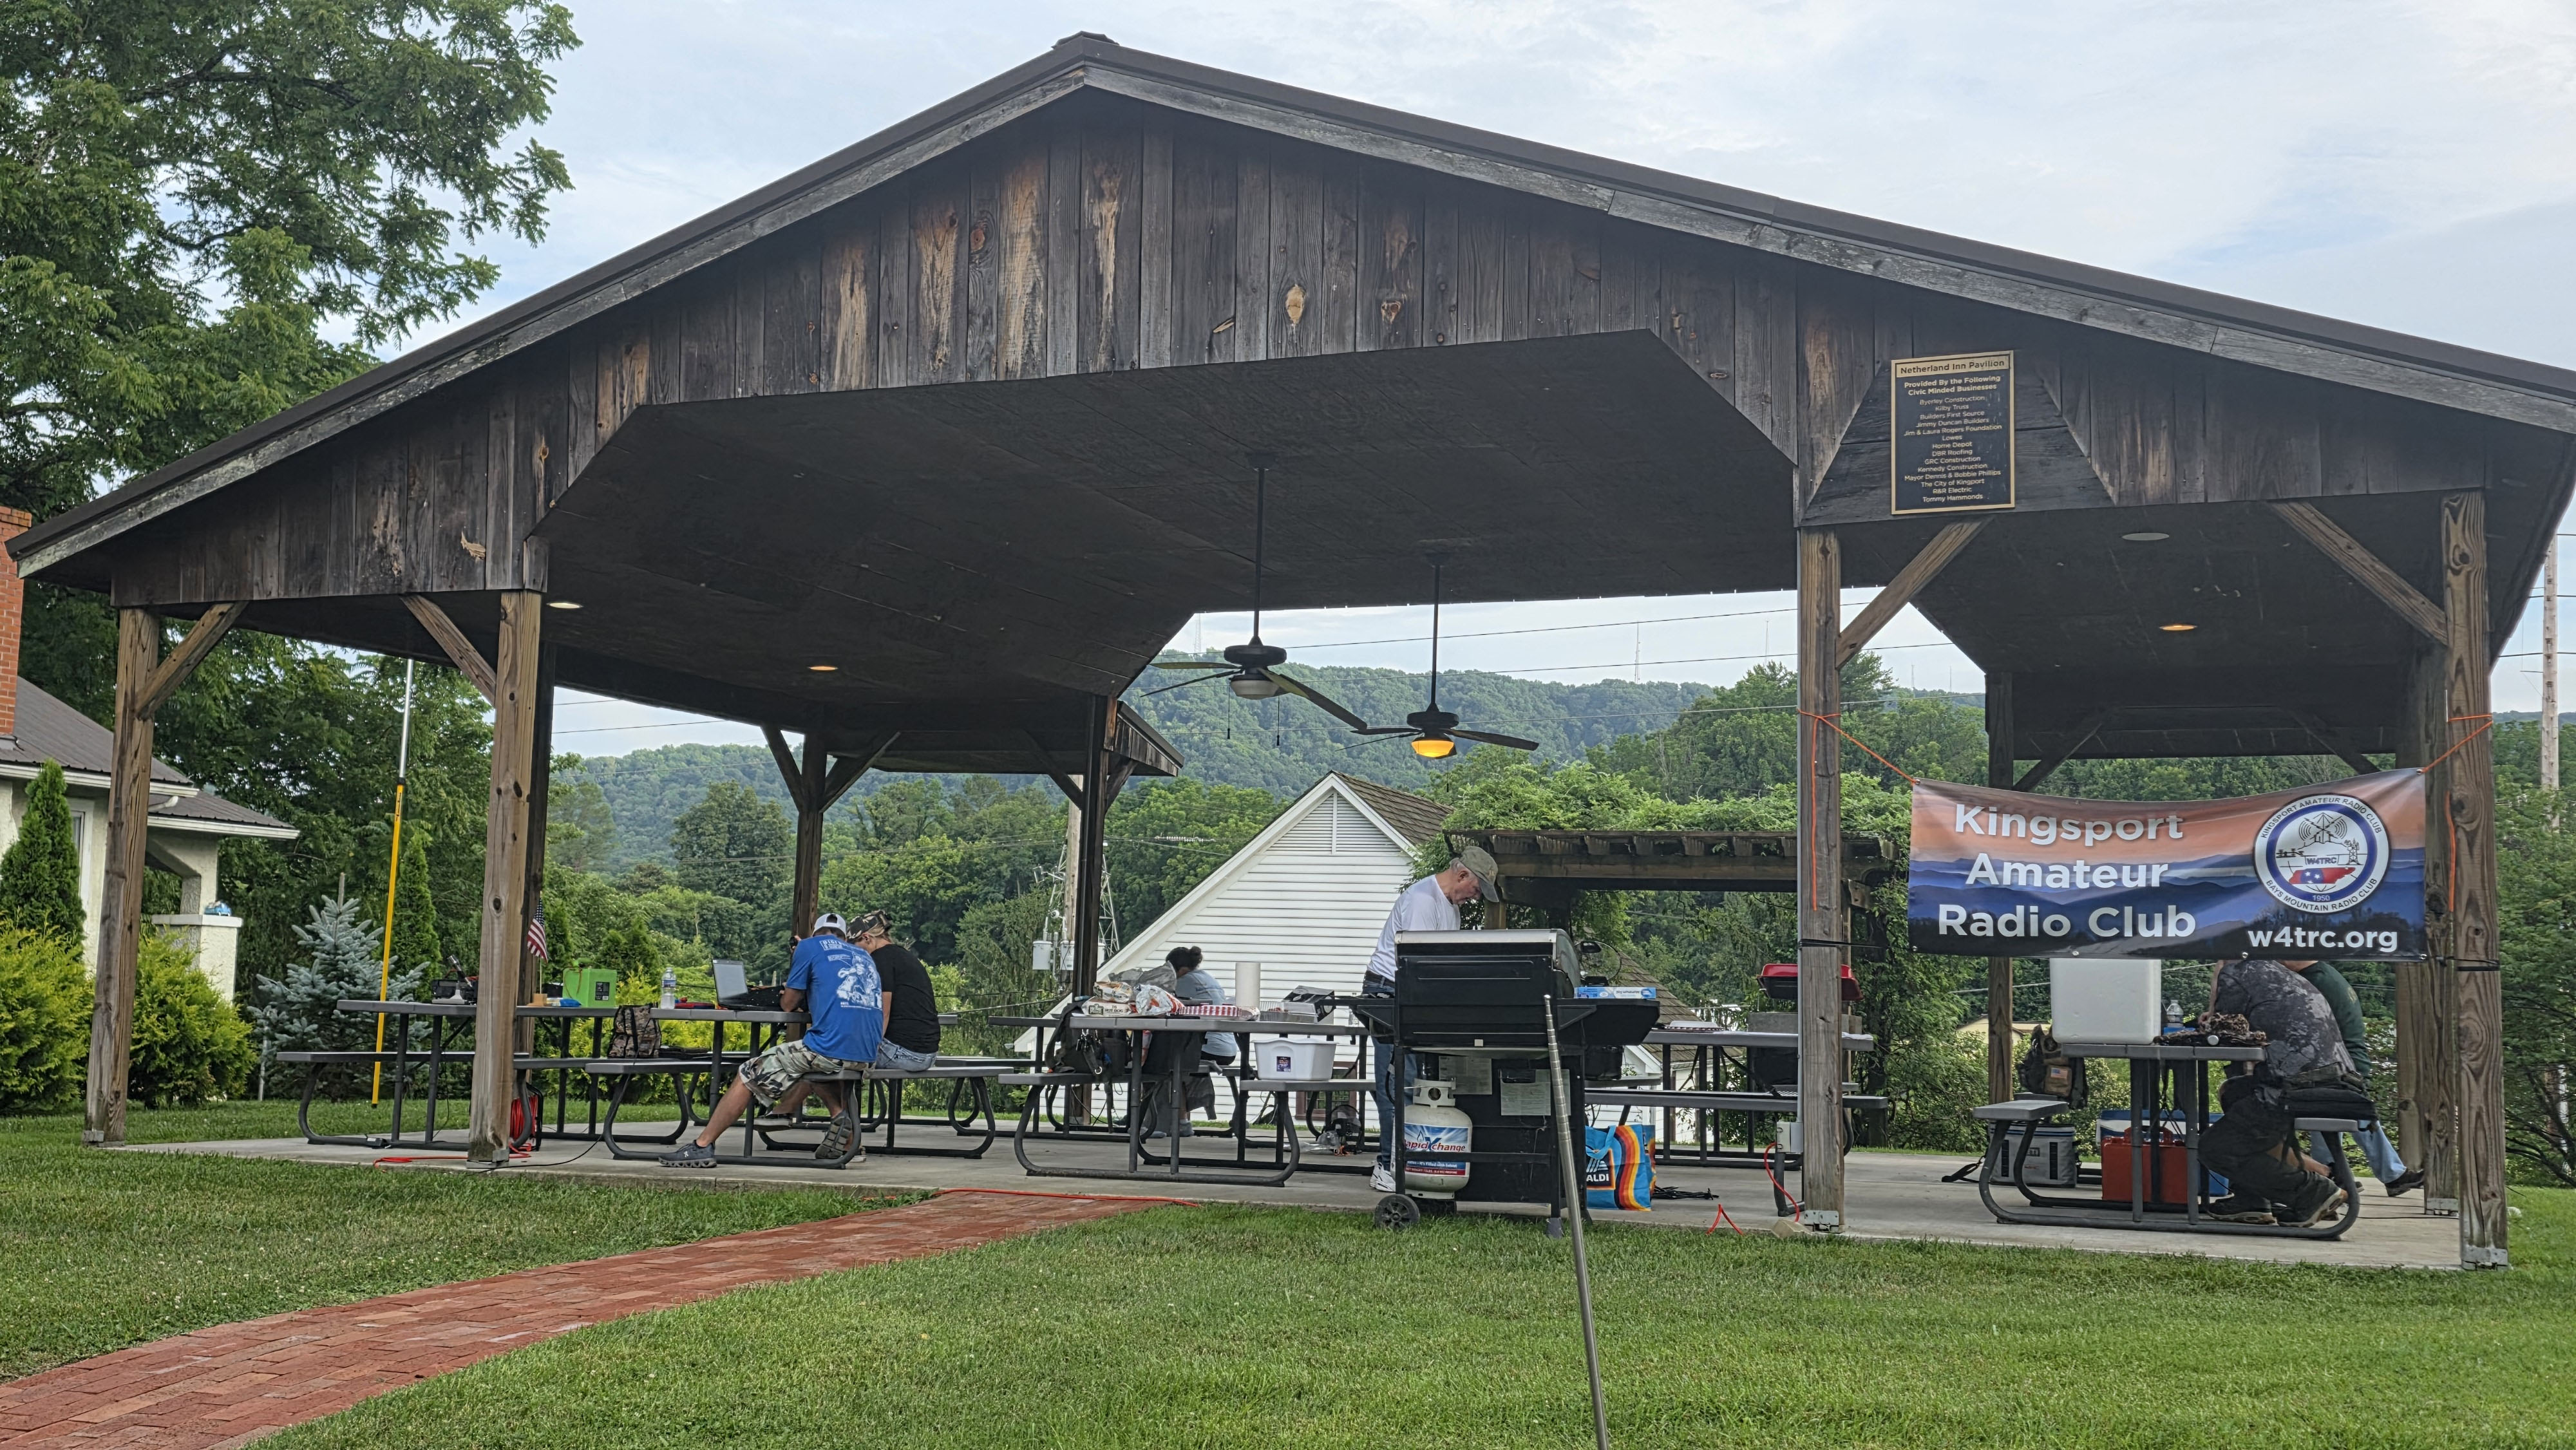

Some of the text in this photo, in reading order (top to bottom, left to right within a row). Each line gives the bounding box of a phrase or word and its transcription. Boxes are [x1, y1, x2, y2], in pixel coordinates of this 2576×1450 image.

[1900, 364, 1949, 374] Netherland
[1969, 360, 2004, 369] Pavilion
[1904, 380, 1937, 388] Provided
[1957, 384, 1997, 392] Businesses
[1955, 804, 2183, 847] Kingsport
[2261, 797, 2382, 838] KINGSPORT AMATEUR RADIO CLUB
[1965, 852, 2168, 889] Amateur
[2306, 857, 2337, 865] W4TRC
[2266, 878, 2378, 911] BAYS MOUNTAIN RADIO CLUB
[1938, 904, 2196, 937] Radio Club
[2248, 926, 2398, 953] w4trc.org
[1586, 1173, 1609, 1182] ALDI
